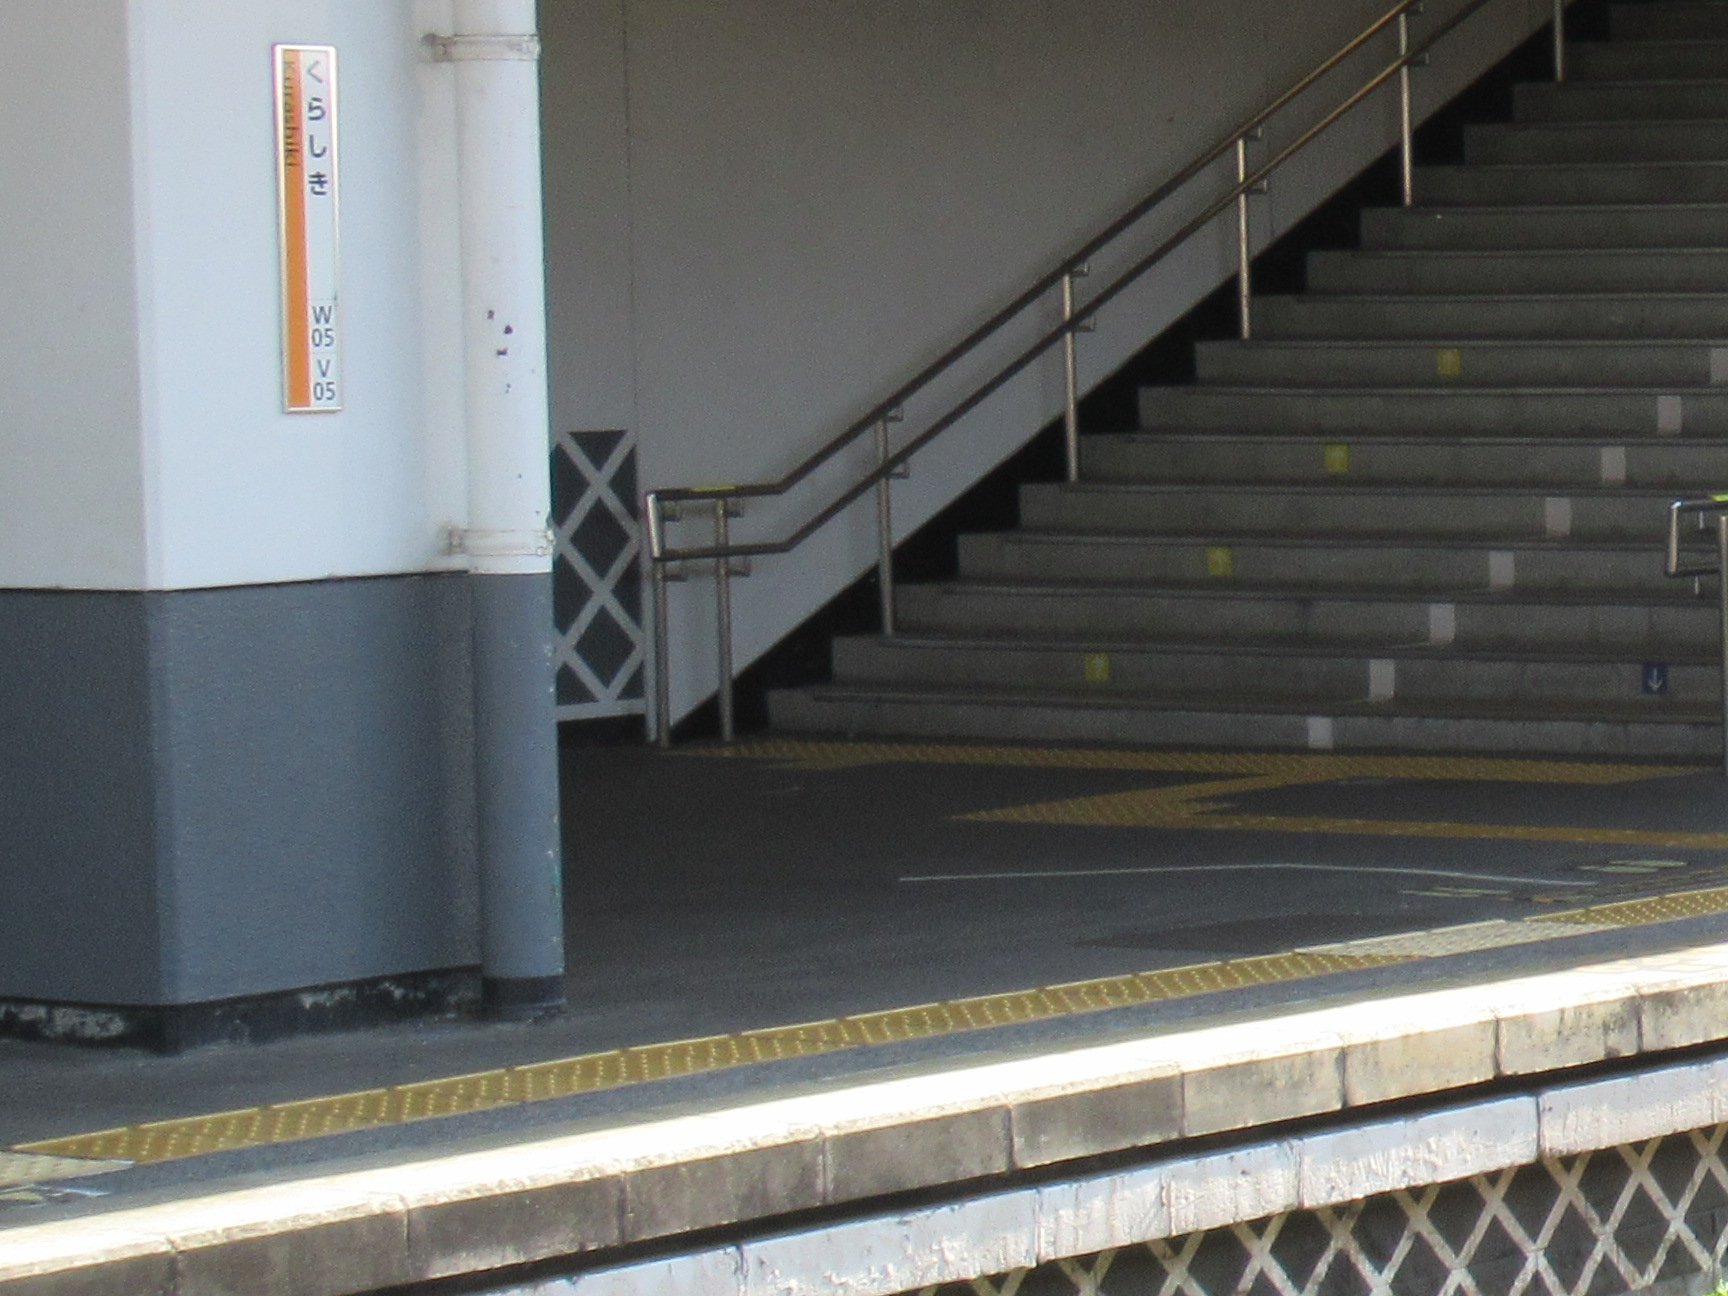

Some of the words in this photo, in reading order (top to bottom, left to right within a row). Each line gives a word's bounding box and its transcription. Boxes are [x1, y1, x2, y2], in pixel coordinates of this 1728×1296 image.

[307, 60, 329, 197] くらしき
[311, 306, 333, 325] W
[311, 328, 334, 348] 05
[316, 360, 331, 379] V
[313, 382, 336, 402] 05
